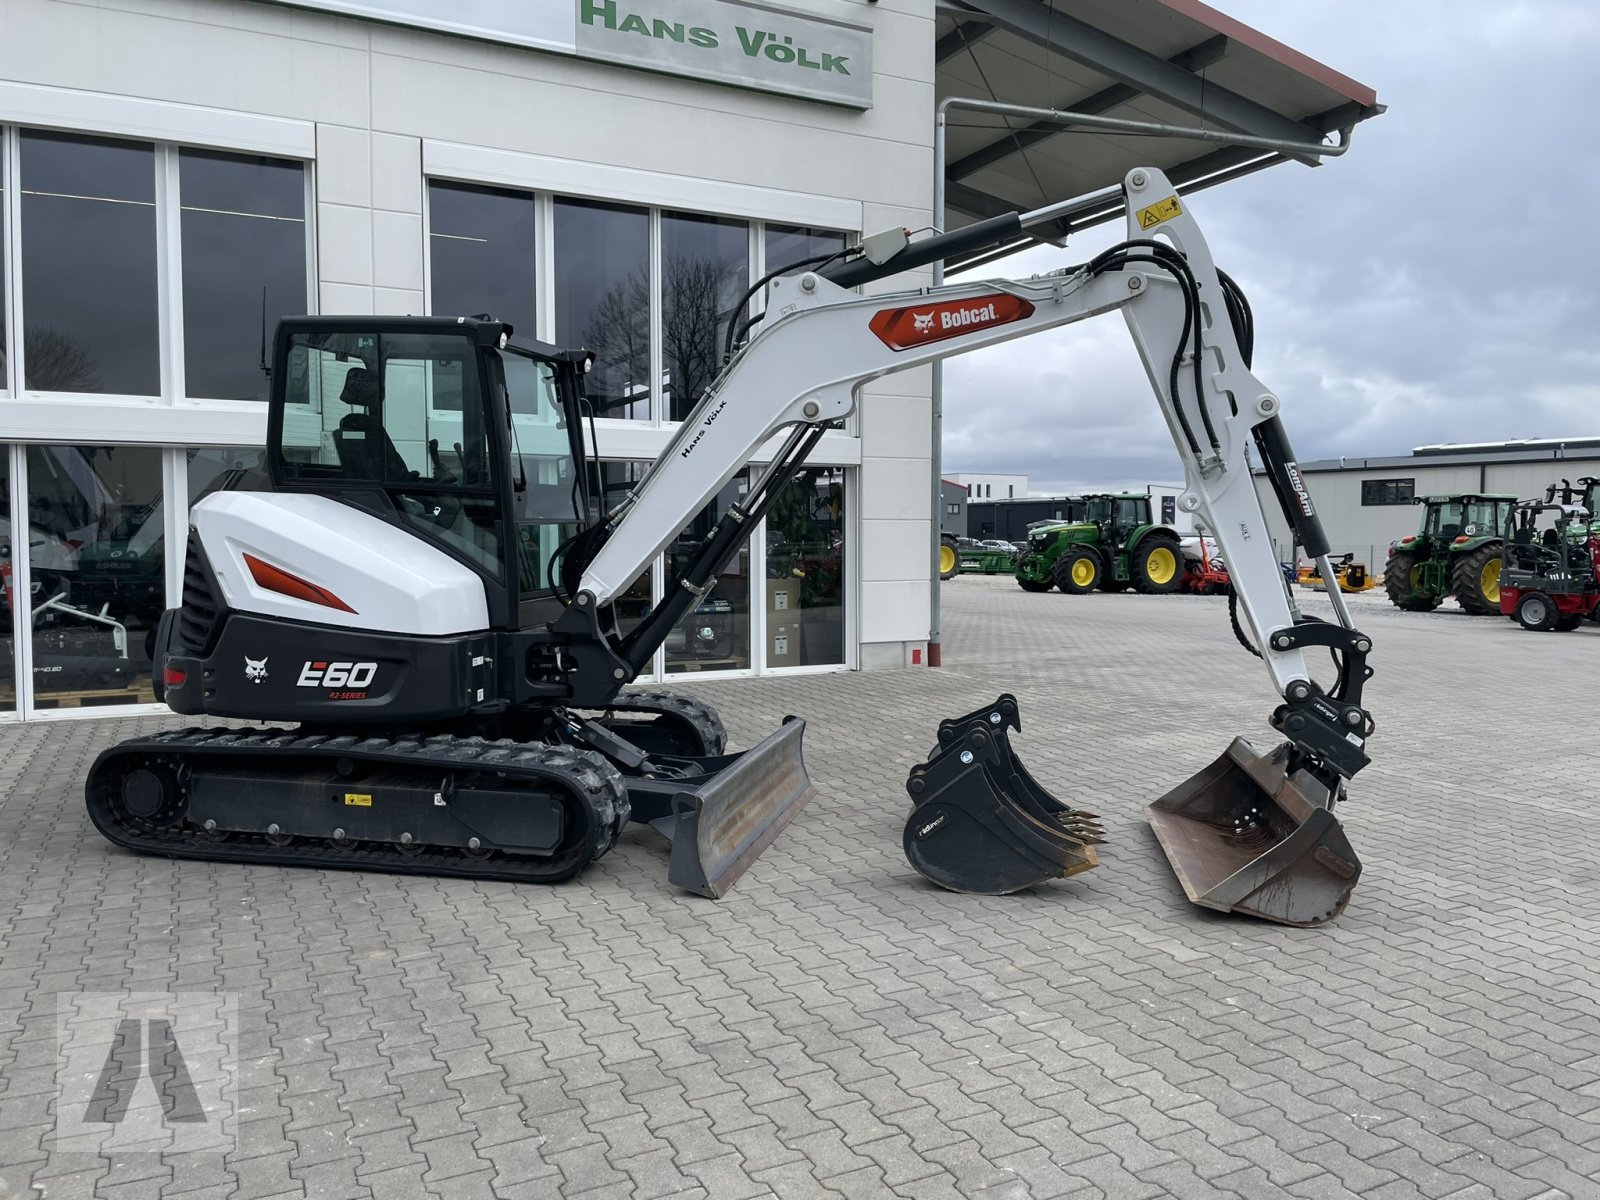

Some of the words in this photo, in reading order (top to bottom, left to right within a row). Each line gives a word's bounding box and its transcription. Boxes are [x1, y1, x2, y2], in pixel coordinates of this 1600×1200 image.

[580, 0, 719, 49] HANS
[735, 26, 851, 75] VÖLK
[941, 303, 996, 329] Bobcat
[681, 429, 706, 458] HANS
[1284, 462, 1314, 517] LongArm
[296, 661, 378, 688] E60
